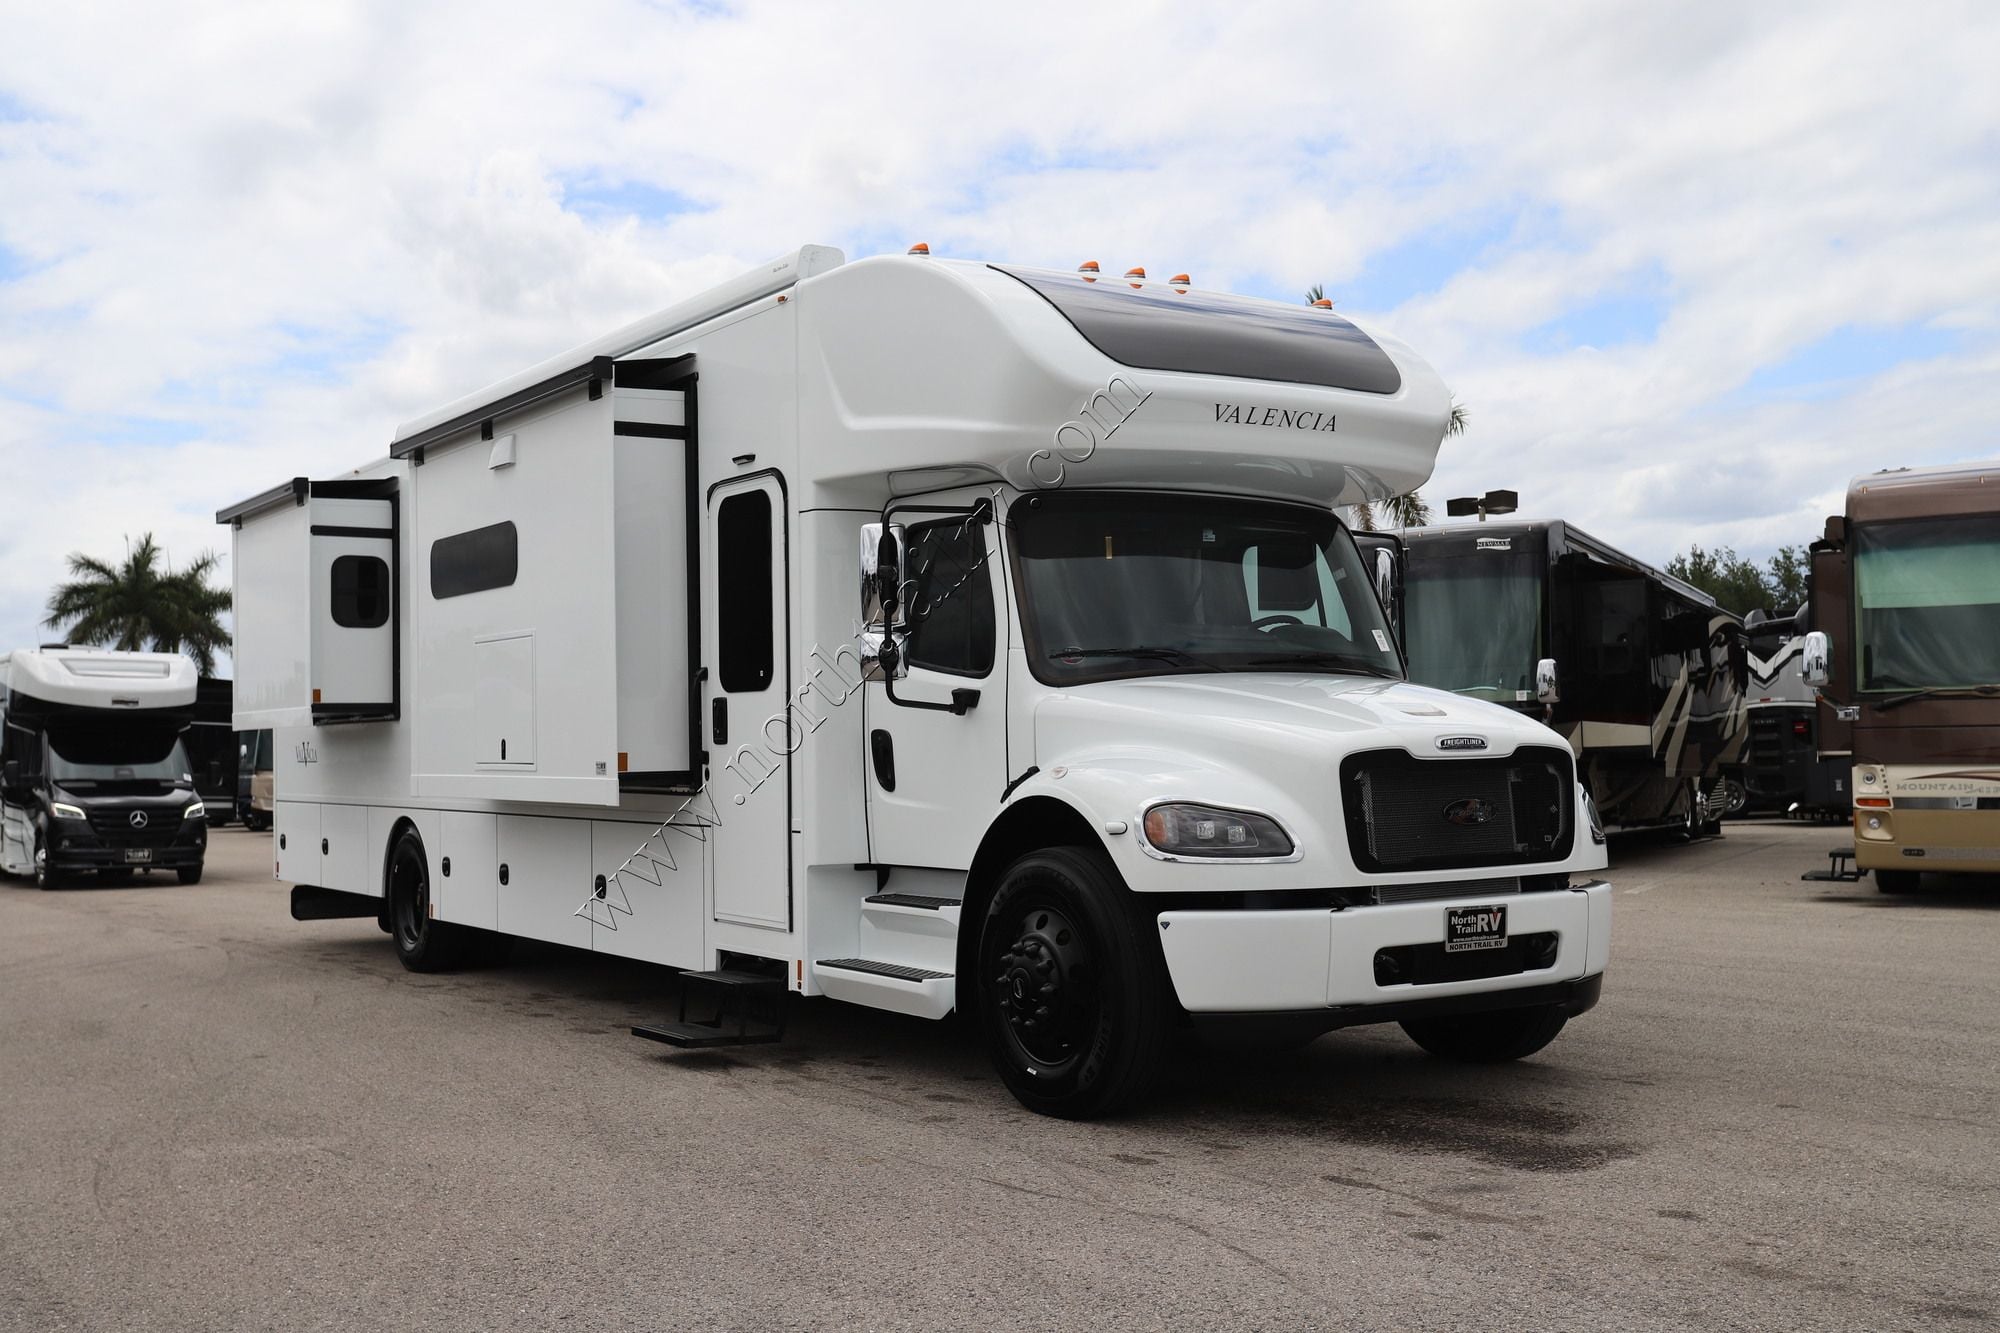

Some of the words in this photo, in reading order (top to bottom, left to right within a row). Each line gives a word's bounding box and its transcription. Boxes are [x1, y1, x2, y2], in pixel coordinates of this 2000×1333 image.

[1213, 402, 1338, 432] VALENCIA
[1896, 783, 1974, 791] MOUNTAIN
[1451, 915, 1477, 925] North
[1477, 912, 1502, 932] RV
[1456, 924, 1477, 934] Trail
[1449, 943, 1472, 951] NORTH
